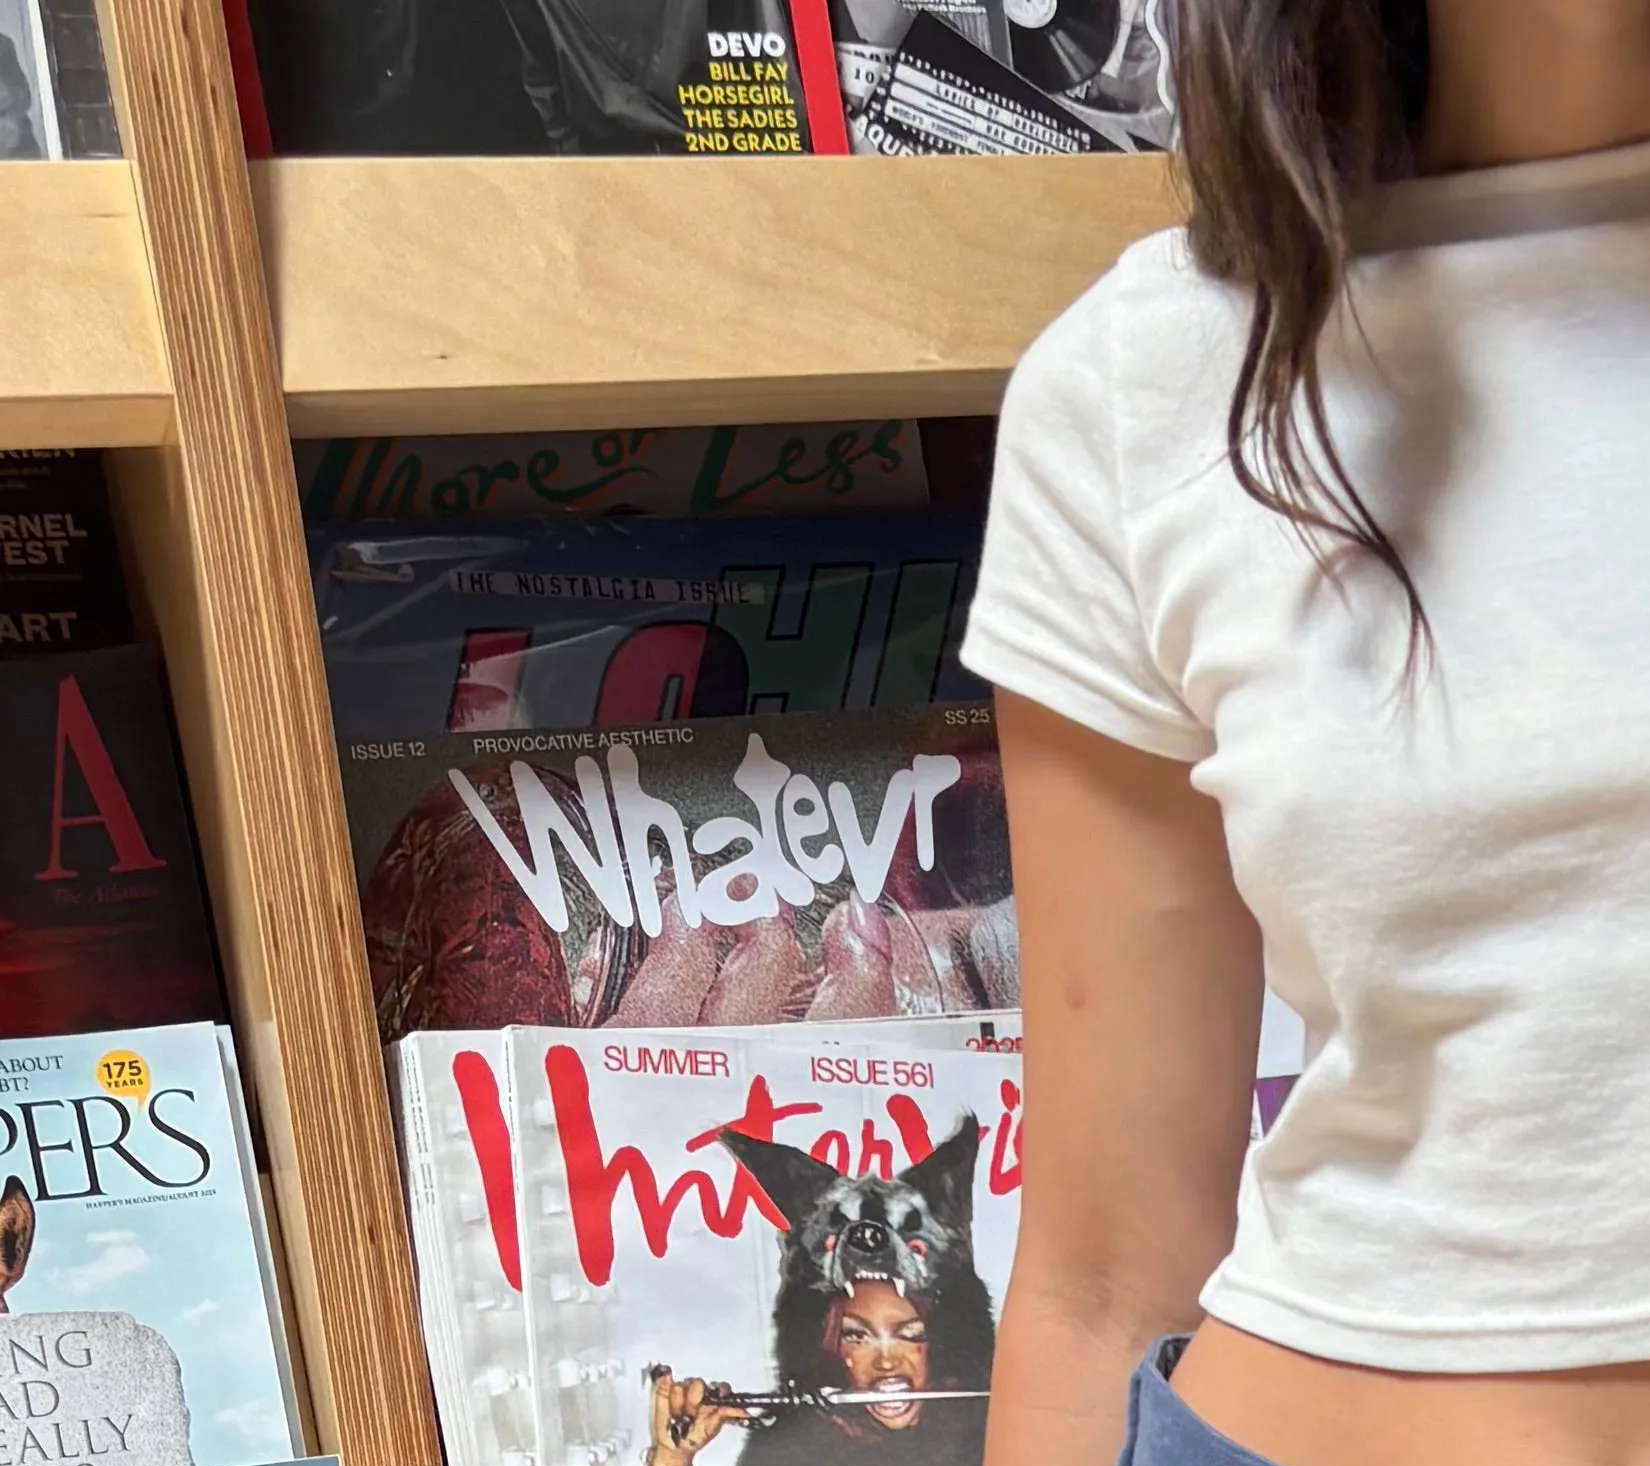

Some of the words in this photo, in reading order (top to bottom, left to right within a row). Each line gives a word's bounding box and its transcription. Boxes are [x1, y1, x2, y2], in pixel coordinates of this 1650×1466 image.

[707, 32, 786, 59] DEVO
[709, 62, 751, 82] BILL
[753, 63, 789, 85] FAY
[678, 84, 795, 106] HORSEGIRL
[683, 108, 726, 129] THE
[728, 108, 798, 129] SADIES
[685, 132, 732, 152] 2ND
[733, 132, 803, 153] GRADE
[0, 540, 70, 566] EST
[456, 571, 496, 594] THE
[516, 574, 657, 602] NOSTALGIA
[676, 579, 752, 605] ISSUE
[944, 710, 969, 726] SS
[970, 708, 992, 725] 25
[350, 743, 405, 762] ISSUE
[407, 741, 426, 759] 12
[472, 732, 597, 757] PROVOCATIVE
[598, 726, 695, 752] AESTHETIC
[33, 674, 168, 881] A
[102, 1059, 143, 1080] 175
[603, 1044, 730, 1079] SUMMER
[809, 1056, 889, 1087] ISSUE
[891, 1060, 935, 1090] 561
[106, 1078, 145, 1090] YEARS
